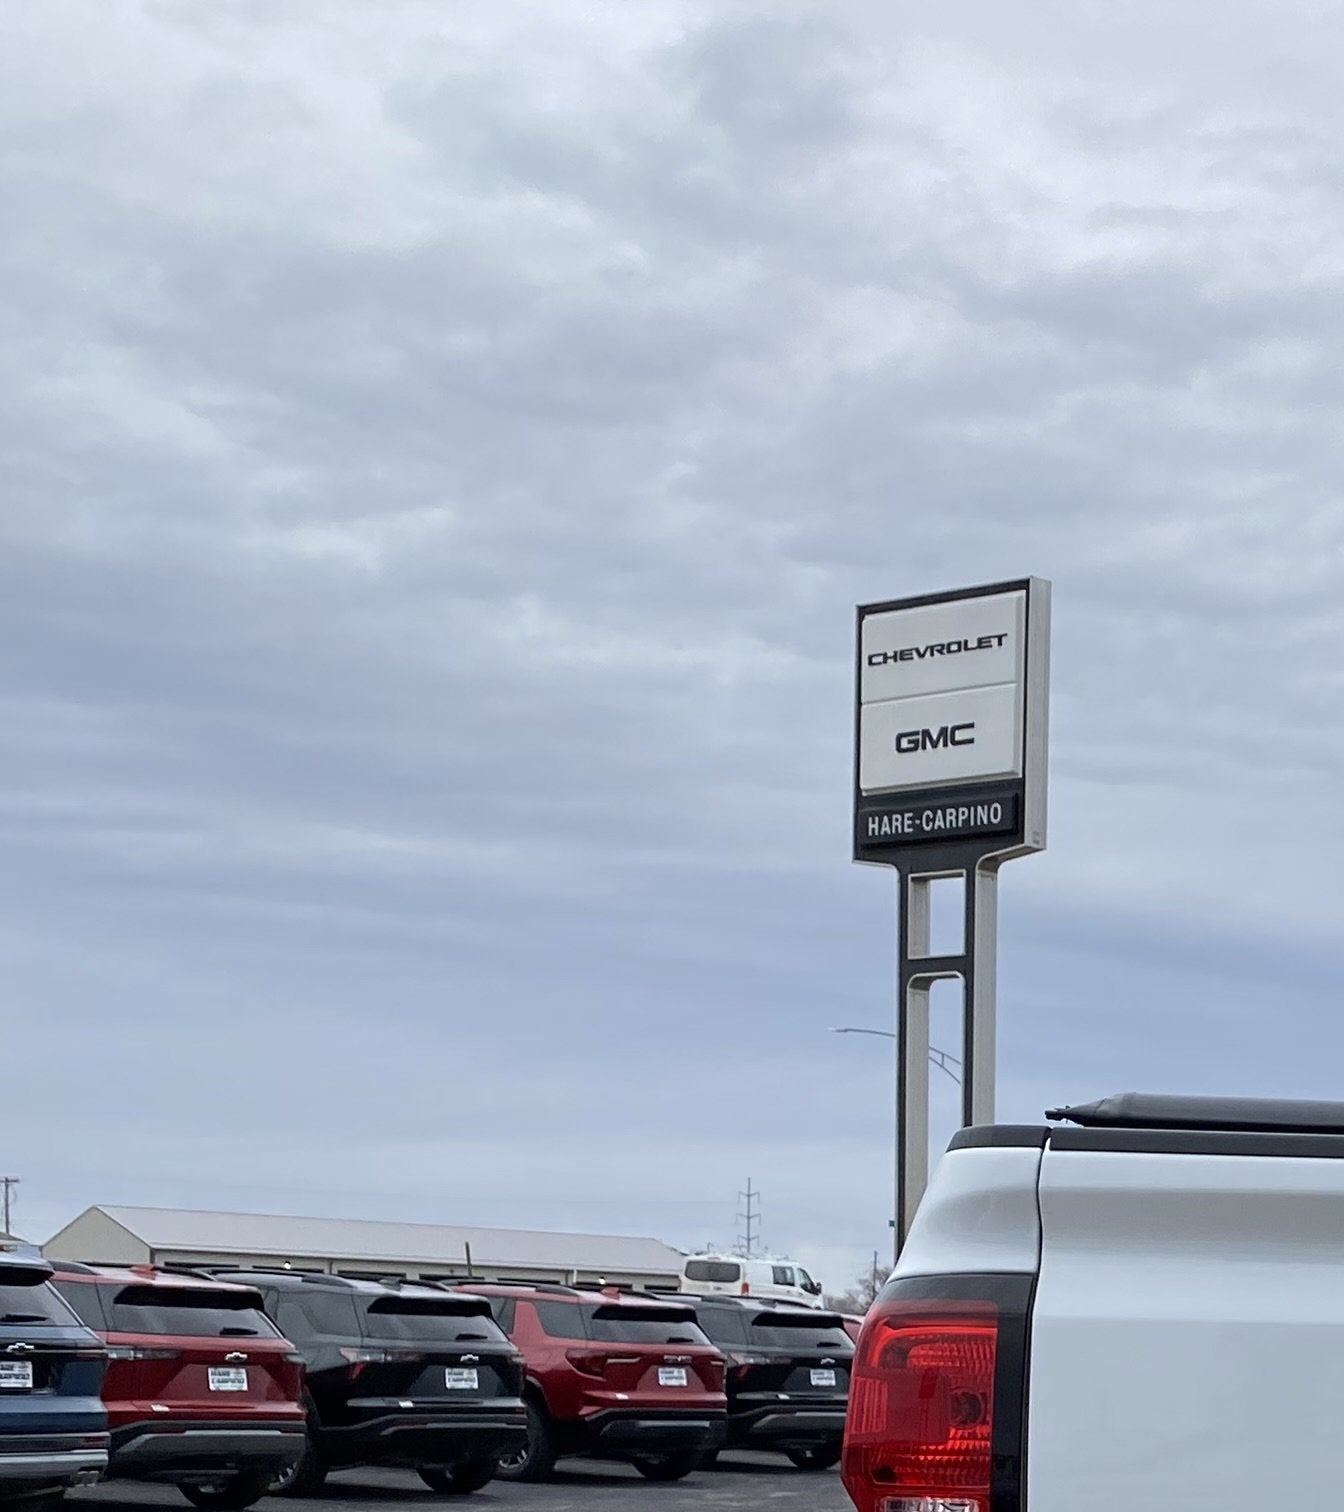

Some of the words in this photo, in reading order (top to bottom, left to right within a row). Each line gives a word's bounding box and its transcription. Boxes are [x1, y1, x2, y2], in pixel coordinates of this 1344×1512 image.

[867, 633, 1008, 666] CHEVROLET
[895, 722, 975, 754] GMC
[867, 802, 1002, 837] HARE-CARPINO
